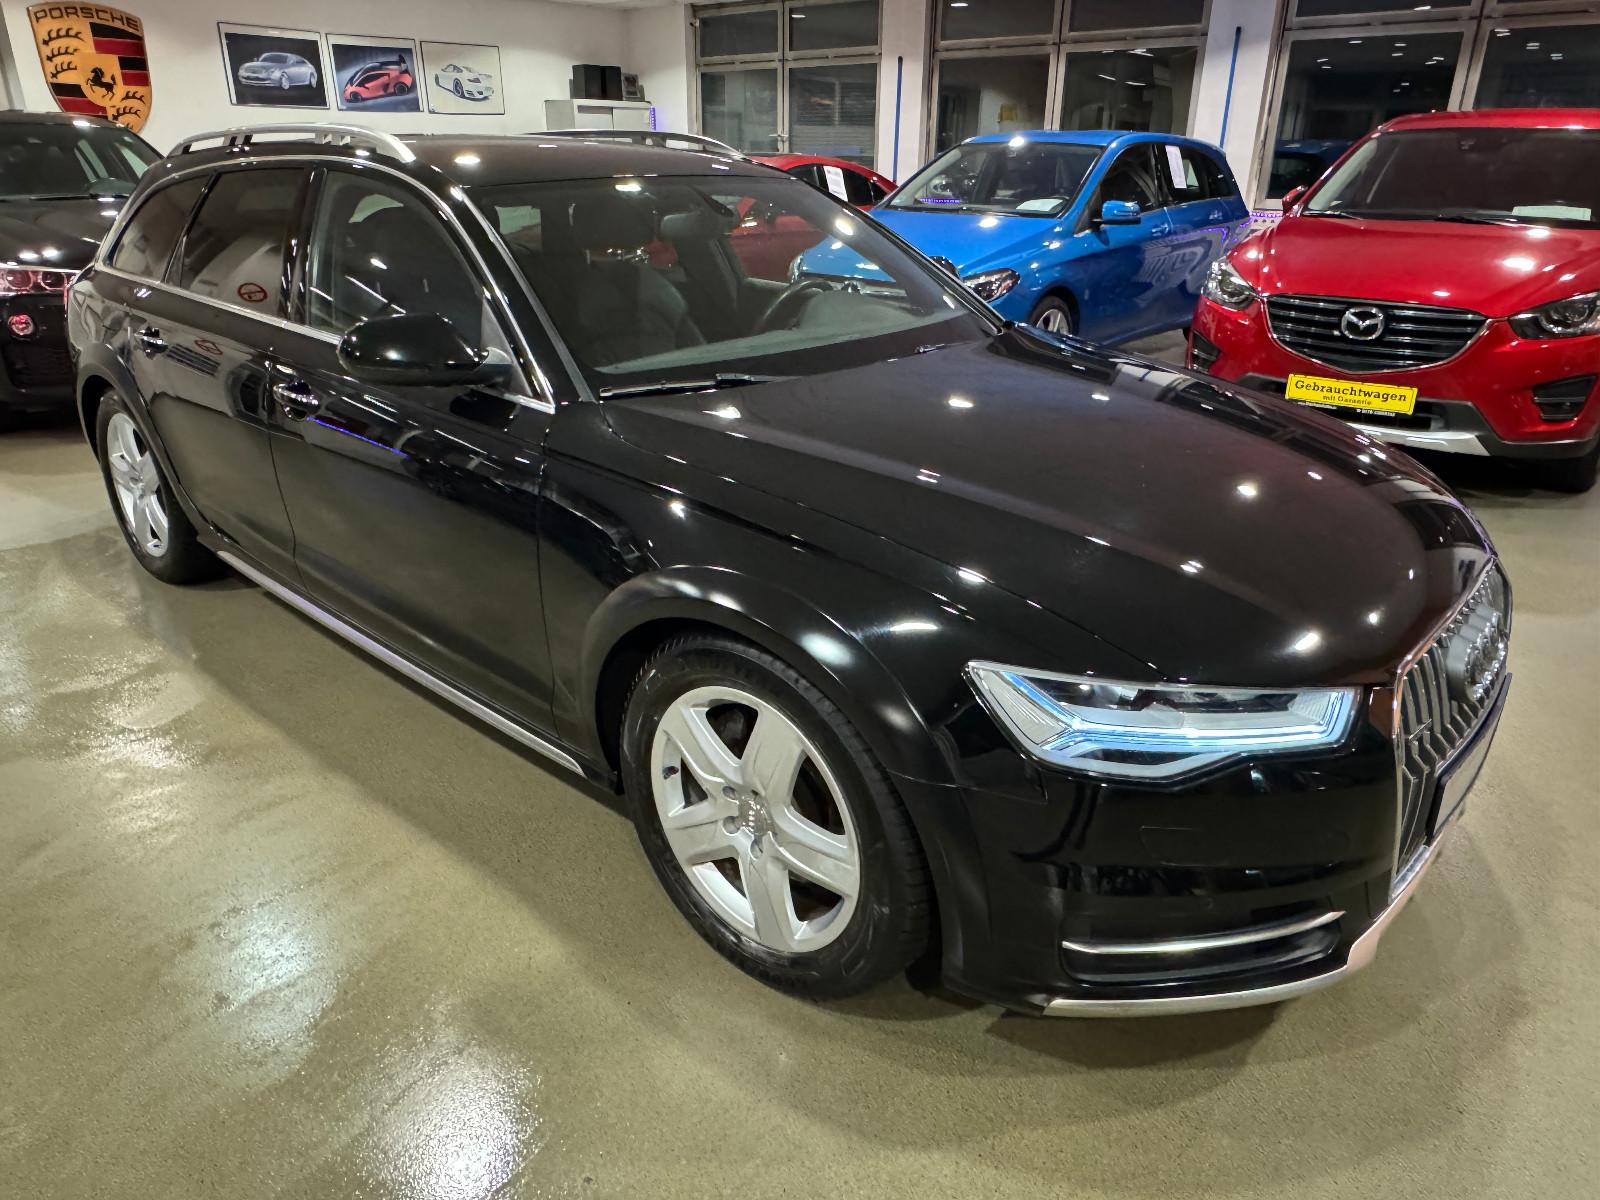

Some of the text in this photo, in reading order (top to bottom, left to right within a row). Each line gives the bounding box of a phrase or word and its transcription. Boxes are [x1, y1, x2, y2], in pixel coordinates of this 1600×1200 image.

[33, 6, 140, 32] PORSCHE
[1294, 380, 1407, 402] Gebrauchtwagen
[1337, 396, 1372, 406] Garantie
